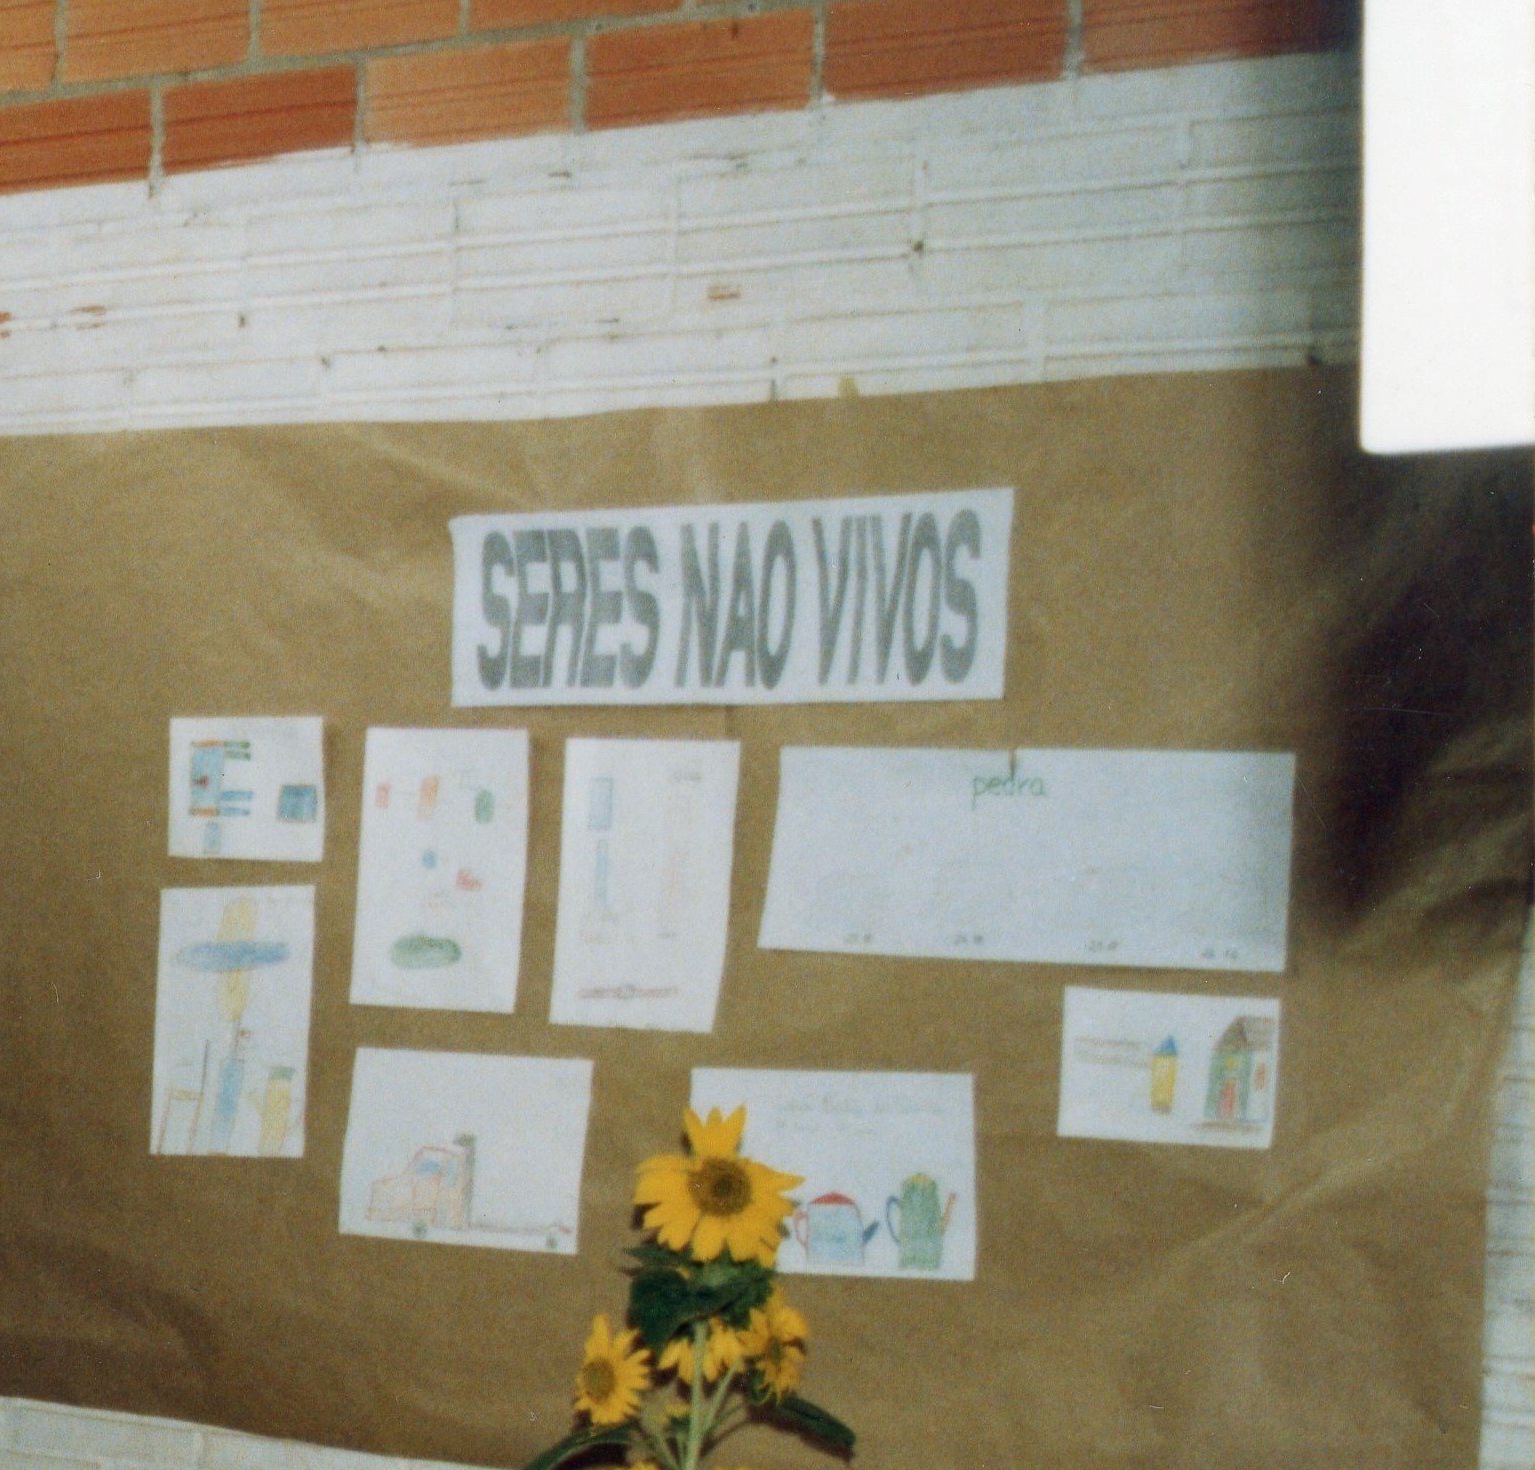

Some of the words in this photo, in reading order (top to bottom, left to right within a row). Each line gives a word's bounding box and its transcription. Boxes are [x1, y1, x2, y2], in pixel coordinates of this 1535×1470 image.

[477, 524, 660, 690] SERES
[813, 508, 983, 687] VIVOS
[972, 767, 1047, 809] pedra
